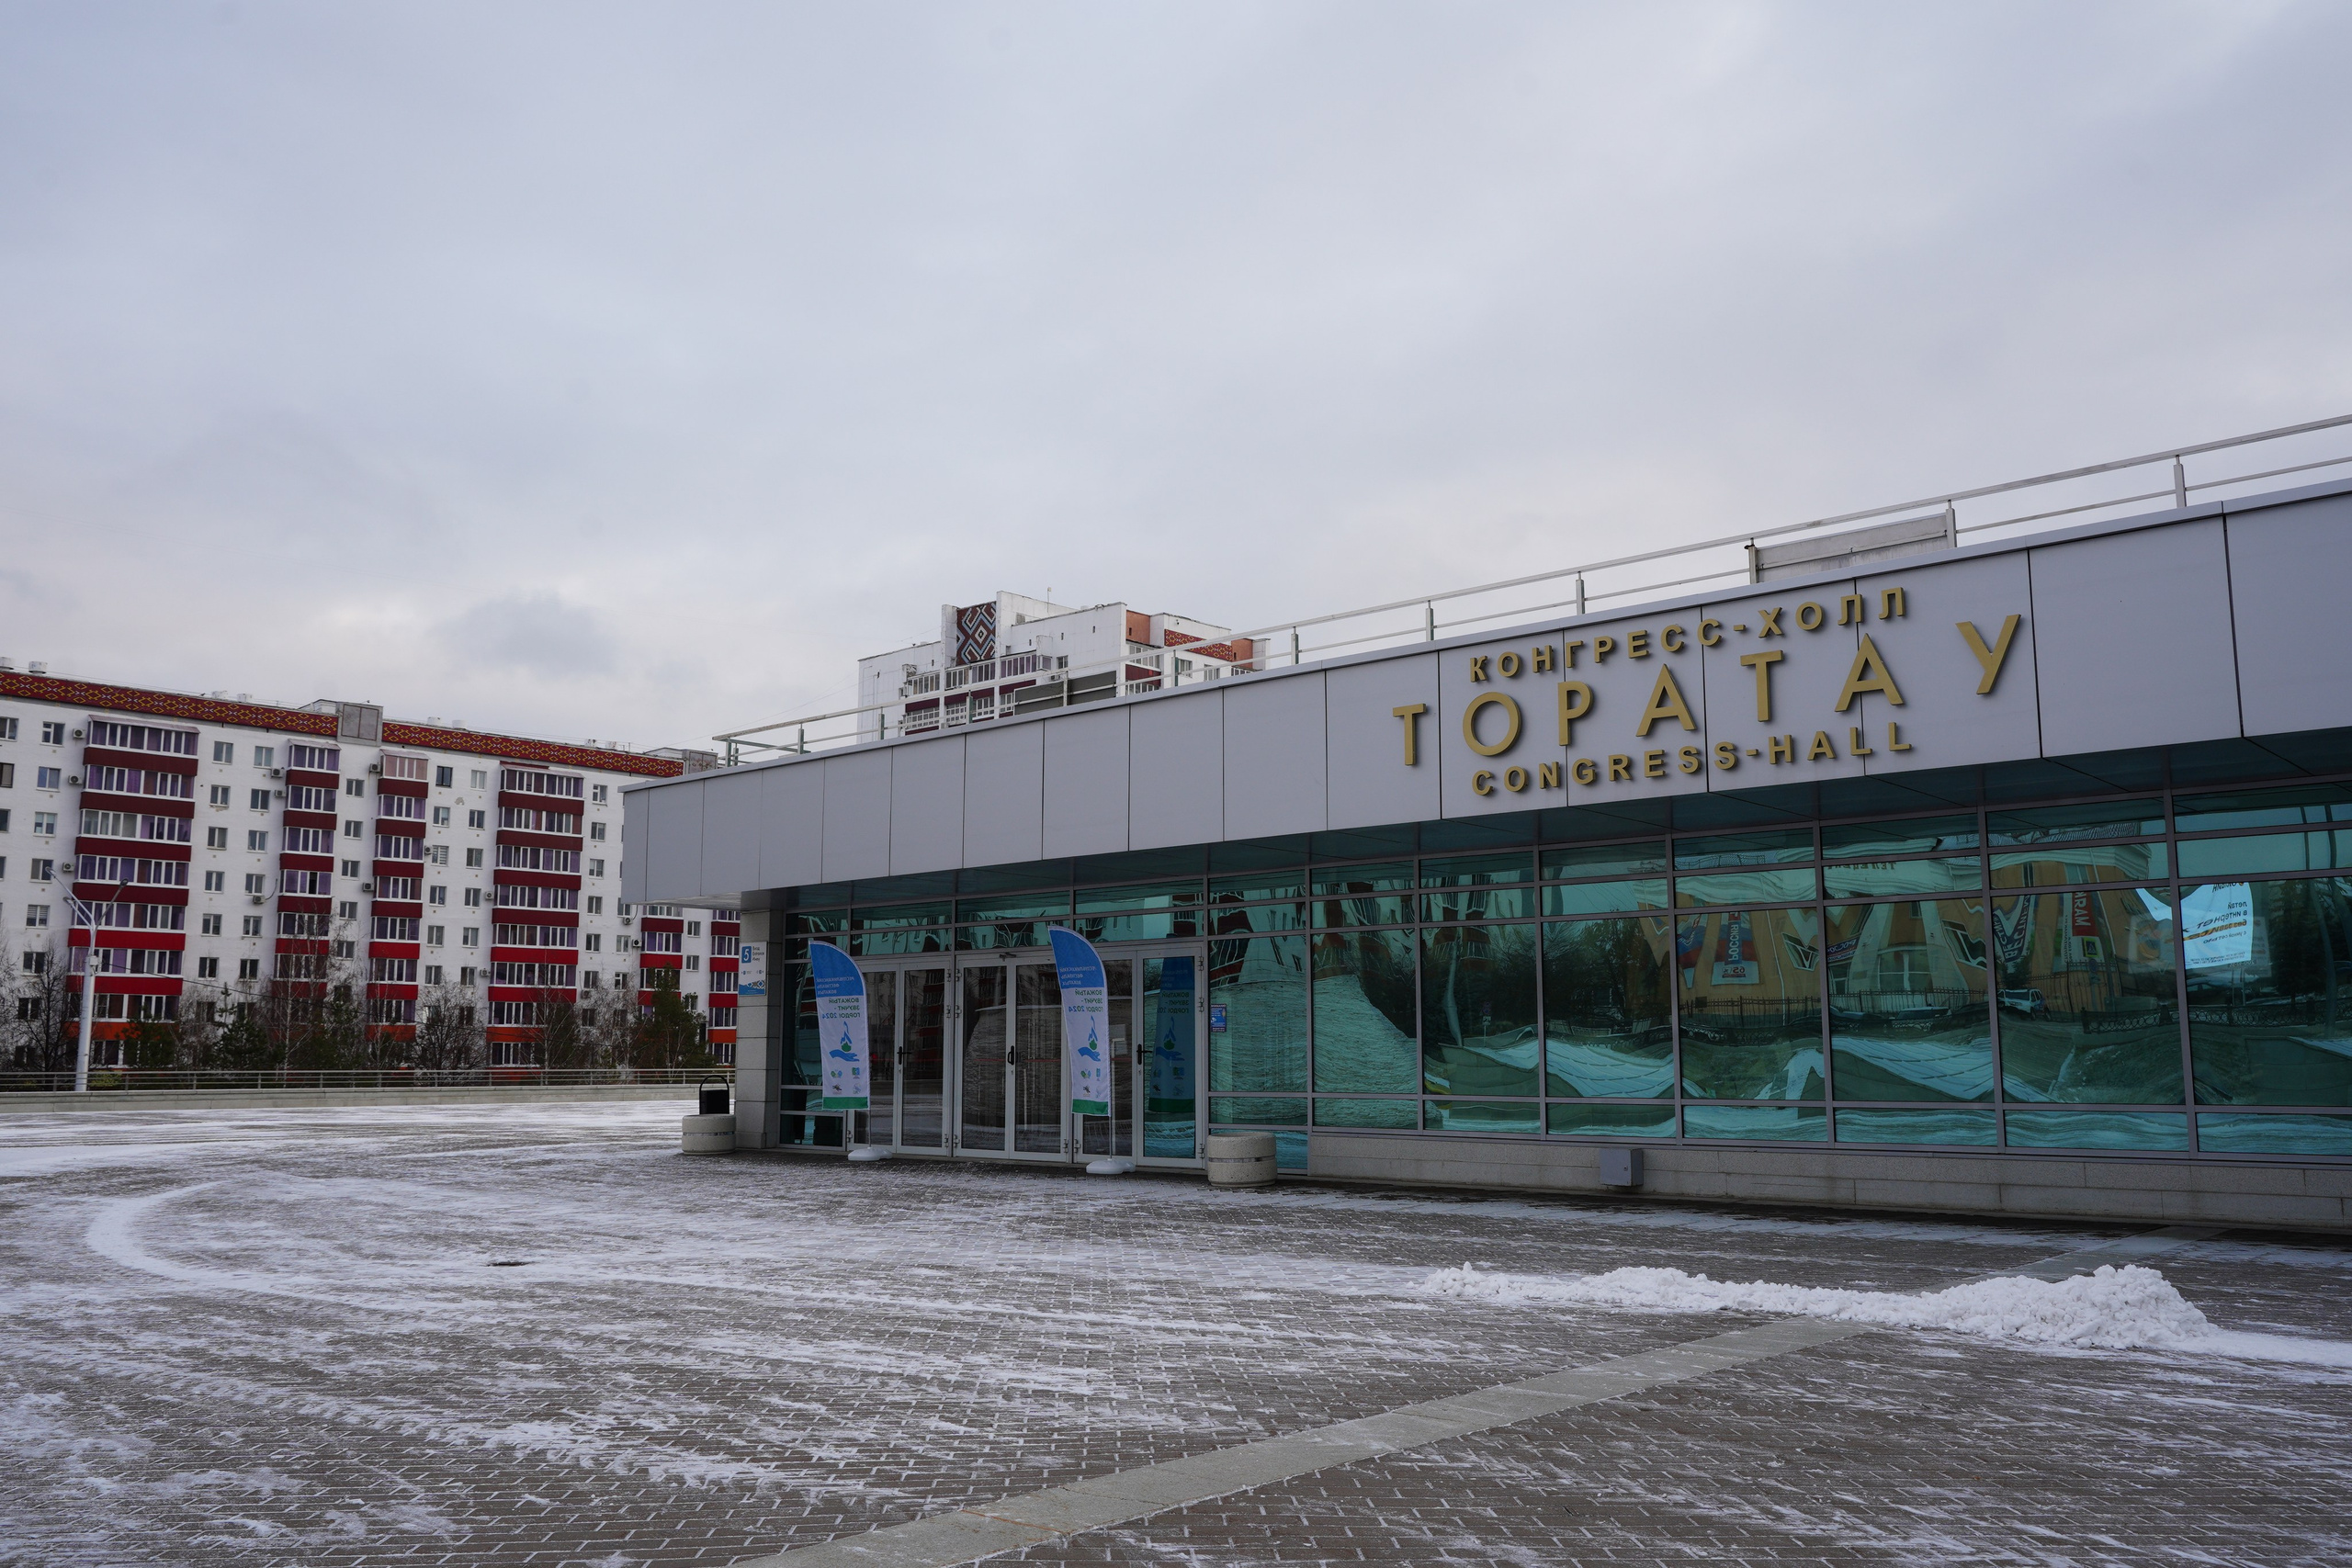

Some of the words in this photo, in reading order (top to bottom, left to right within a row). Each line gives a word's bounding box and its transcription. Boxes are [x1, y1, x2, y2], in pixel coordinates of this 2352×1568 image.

[1469, 586, 1907, 683] КОНГРЕСС-ХОЛЛ
[1393, 613, 2021, 766] ТОРАТАУ
[1472, 721, 1913, 796] CONGRESS-HALL
[743, 949, 750, 961] 5
